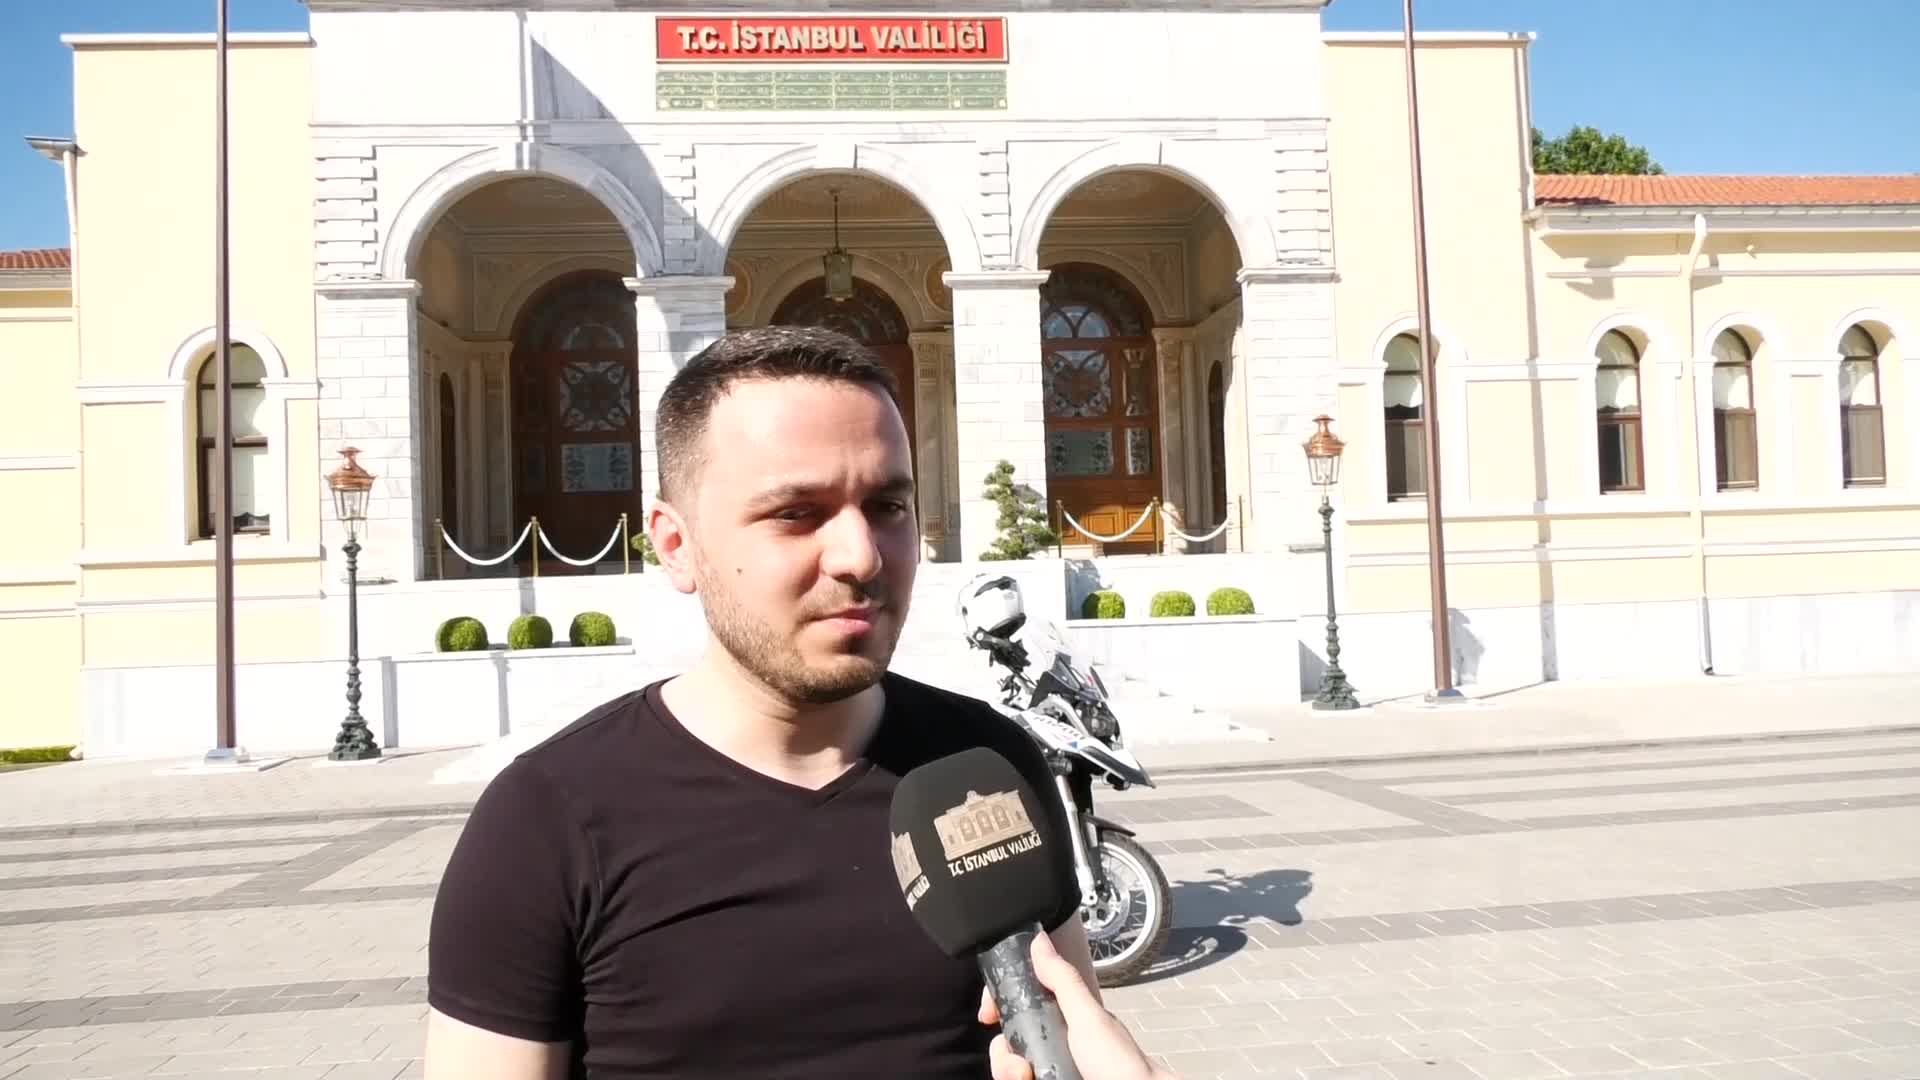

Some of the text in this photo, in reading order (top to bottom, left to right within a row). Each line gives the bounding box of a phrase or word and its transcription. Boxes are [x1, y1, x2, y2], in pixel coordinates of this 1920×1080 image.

[677, 20, 986, 51] T.C. İSTANBUL VALİLİĞİ
[963, 846, 1010, 872] İSTANBUL
[1007, 831, 1042, 855] VALİLİĞİ
